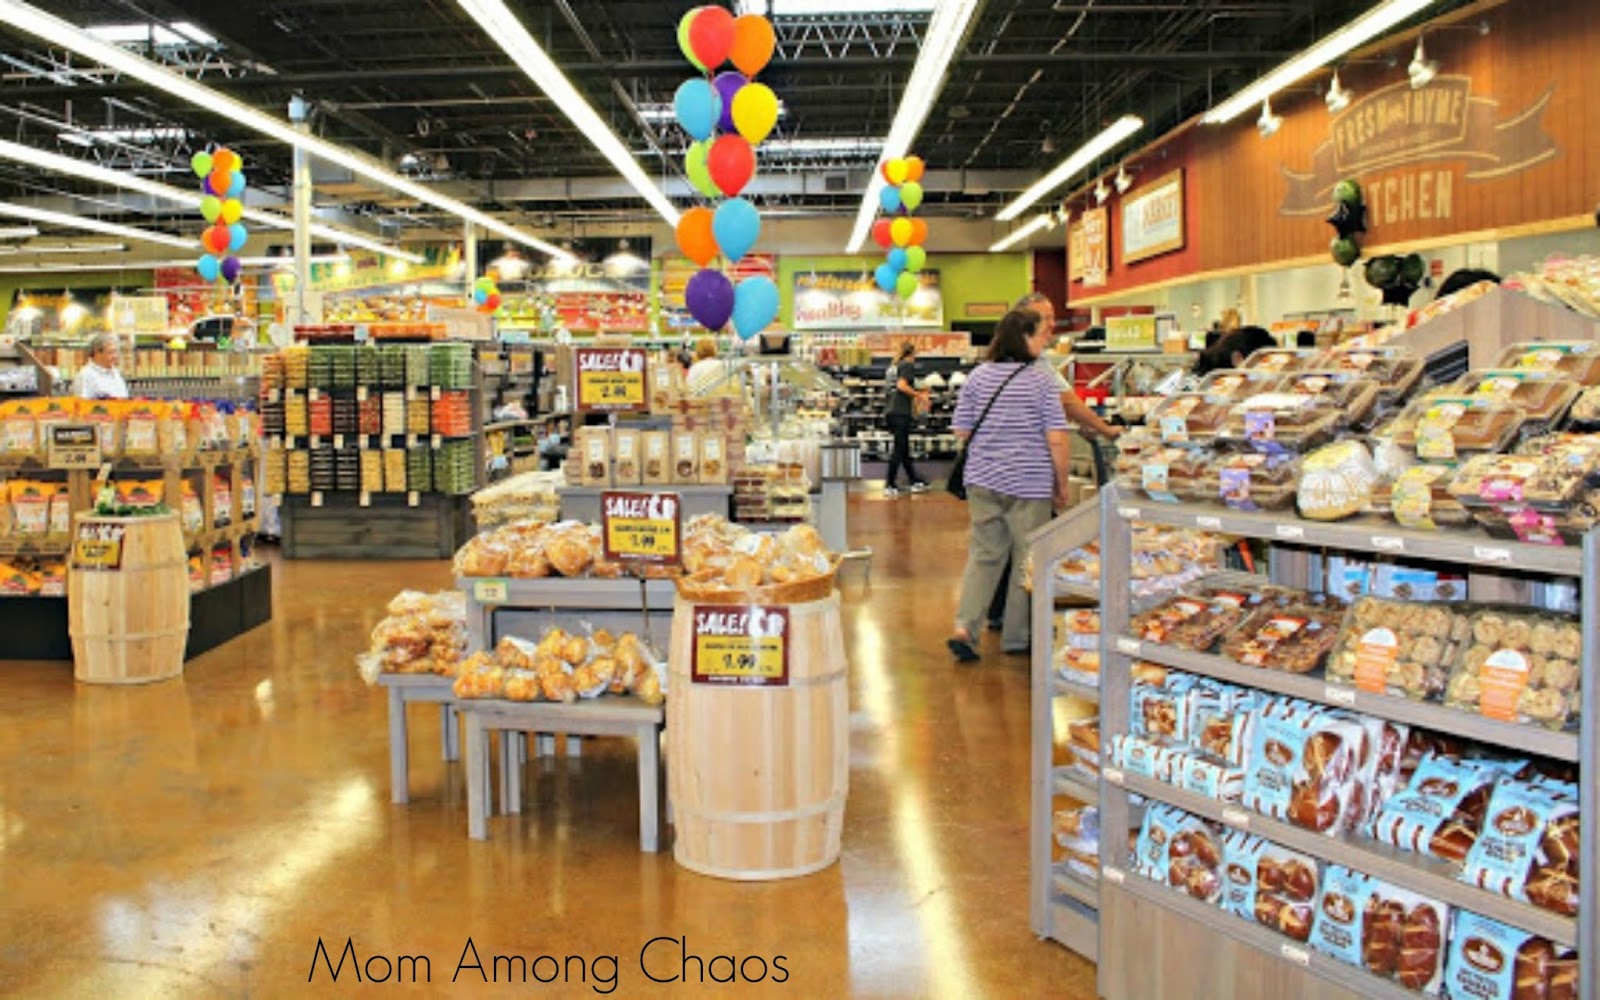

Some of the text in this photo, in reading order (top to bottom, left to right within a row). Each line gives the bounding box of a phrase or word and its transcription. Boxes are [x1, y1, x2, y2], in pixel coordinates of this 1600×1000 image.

[1336, 99, 1388, 157] FRESH
[1402, 87, 1464, 126] THYME
[1366, 169, 1453, 227] TCHEN
[579, 352, 620, 370] SALE!
[605, 496, 648, 518] SALE!
[696, 610, 747, 635] SALE!
